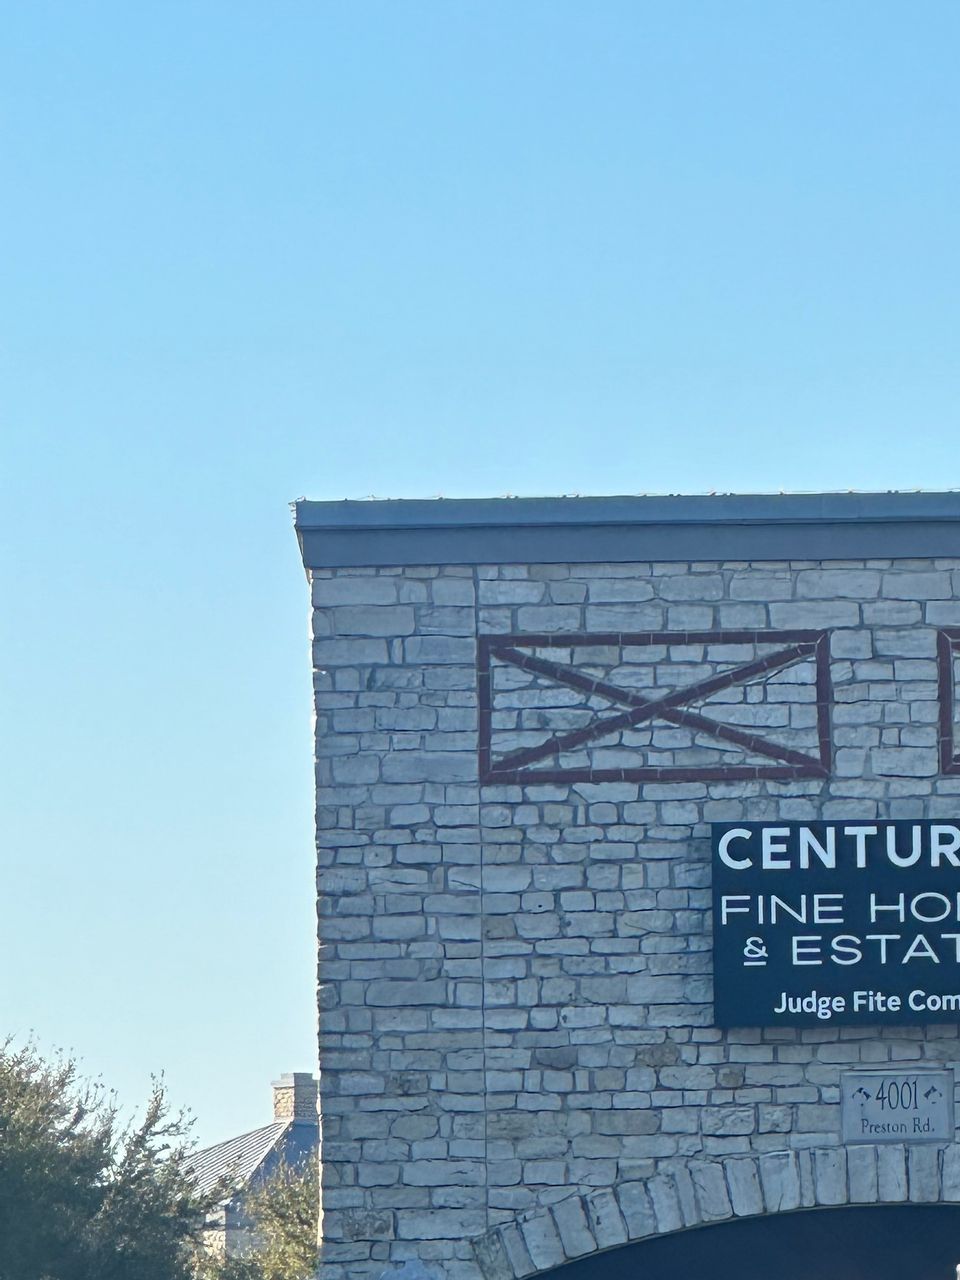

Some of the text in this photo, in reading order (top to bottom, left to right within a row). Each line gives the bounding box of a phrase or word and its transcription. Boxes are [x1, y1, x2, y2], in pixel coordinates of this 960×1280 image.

[721, 893, 844, 925] FINE
[743, 936, 769, 966] &
[774, 990, 846, 1020] Judge
[853, 990, 902, 1013] Fite
[875, 1080, 920, 1111] 4001
[861, 1117, 936, 1134] Preston Rd.
